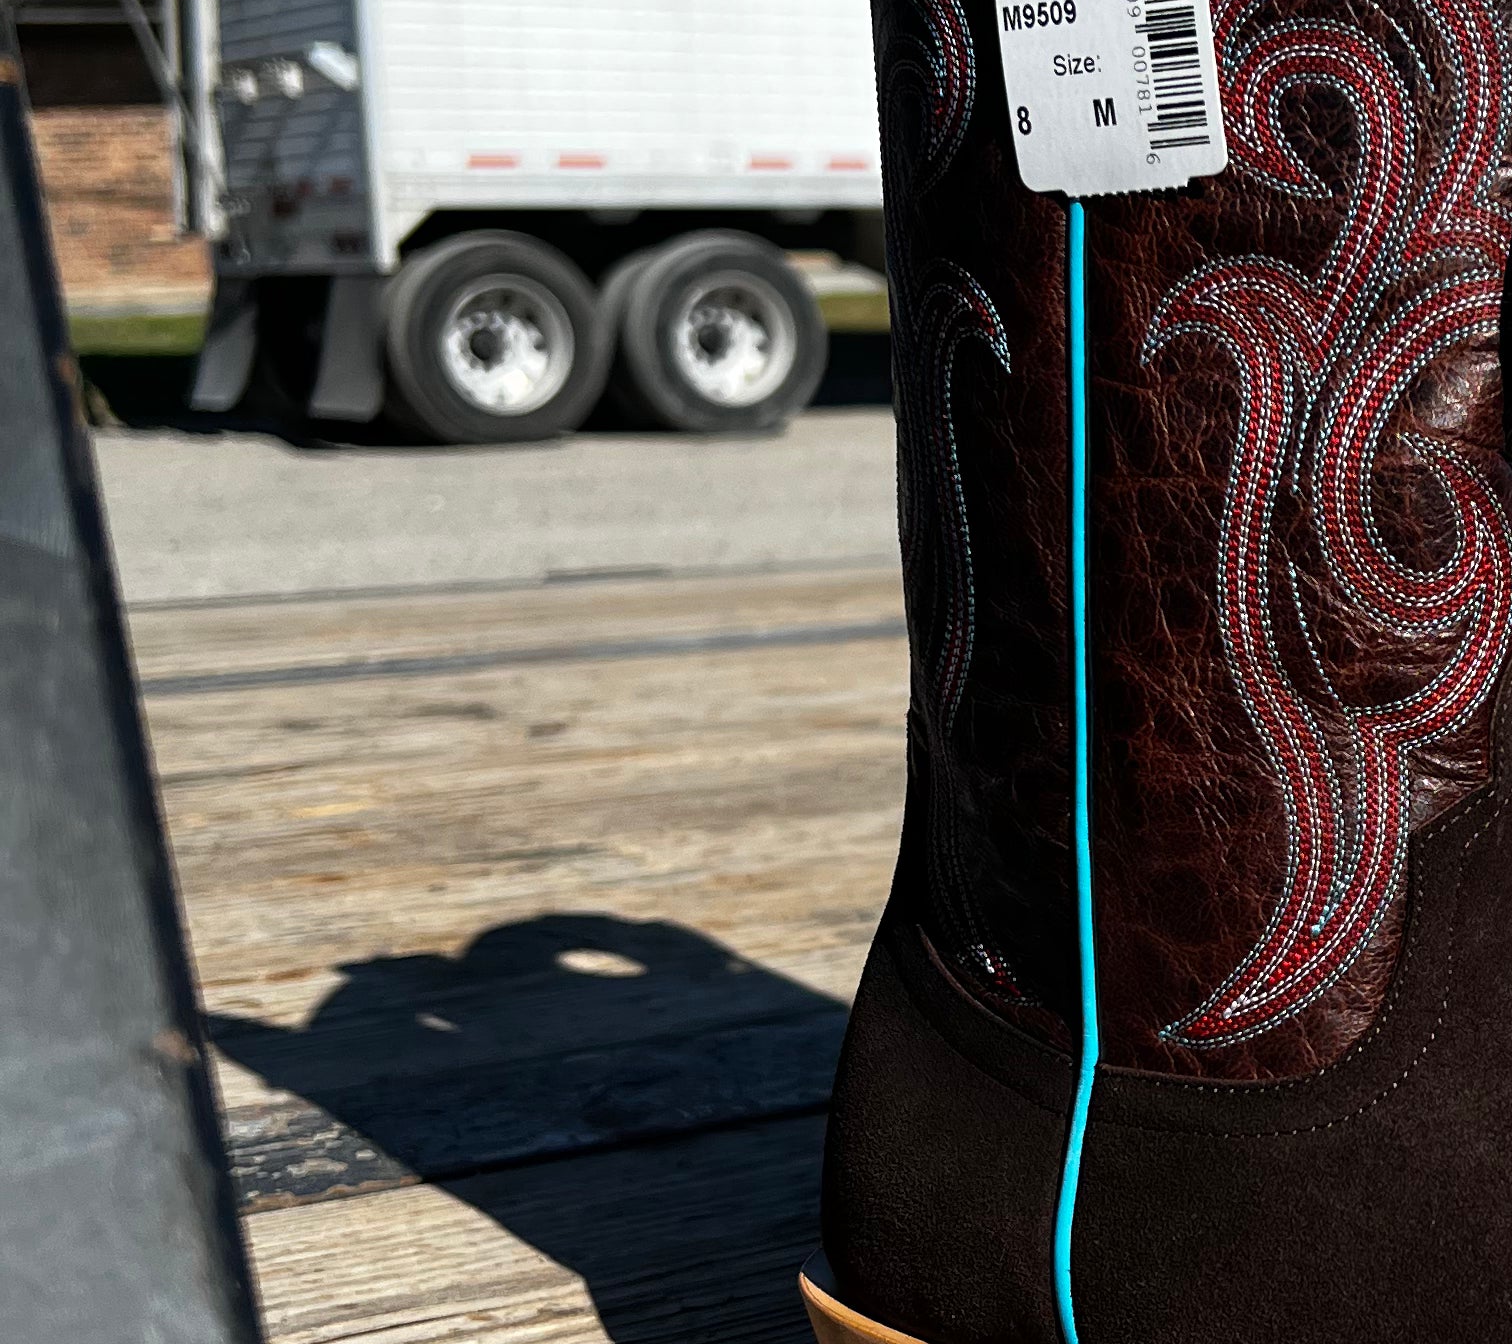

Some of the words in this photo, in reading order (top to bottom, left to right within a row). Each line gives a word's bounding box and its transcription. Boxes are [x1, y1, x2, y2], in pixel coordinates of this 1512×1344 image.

[1053, 53, 1102, 76] Size:
[1132, 46, 1153, 115] 00781
[1016, 105, 1032, 136] 8
[1092, 97, 1118, 128] M
